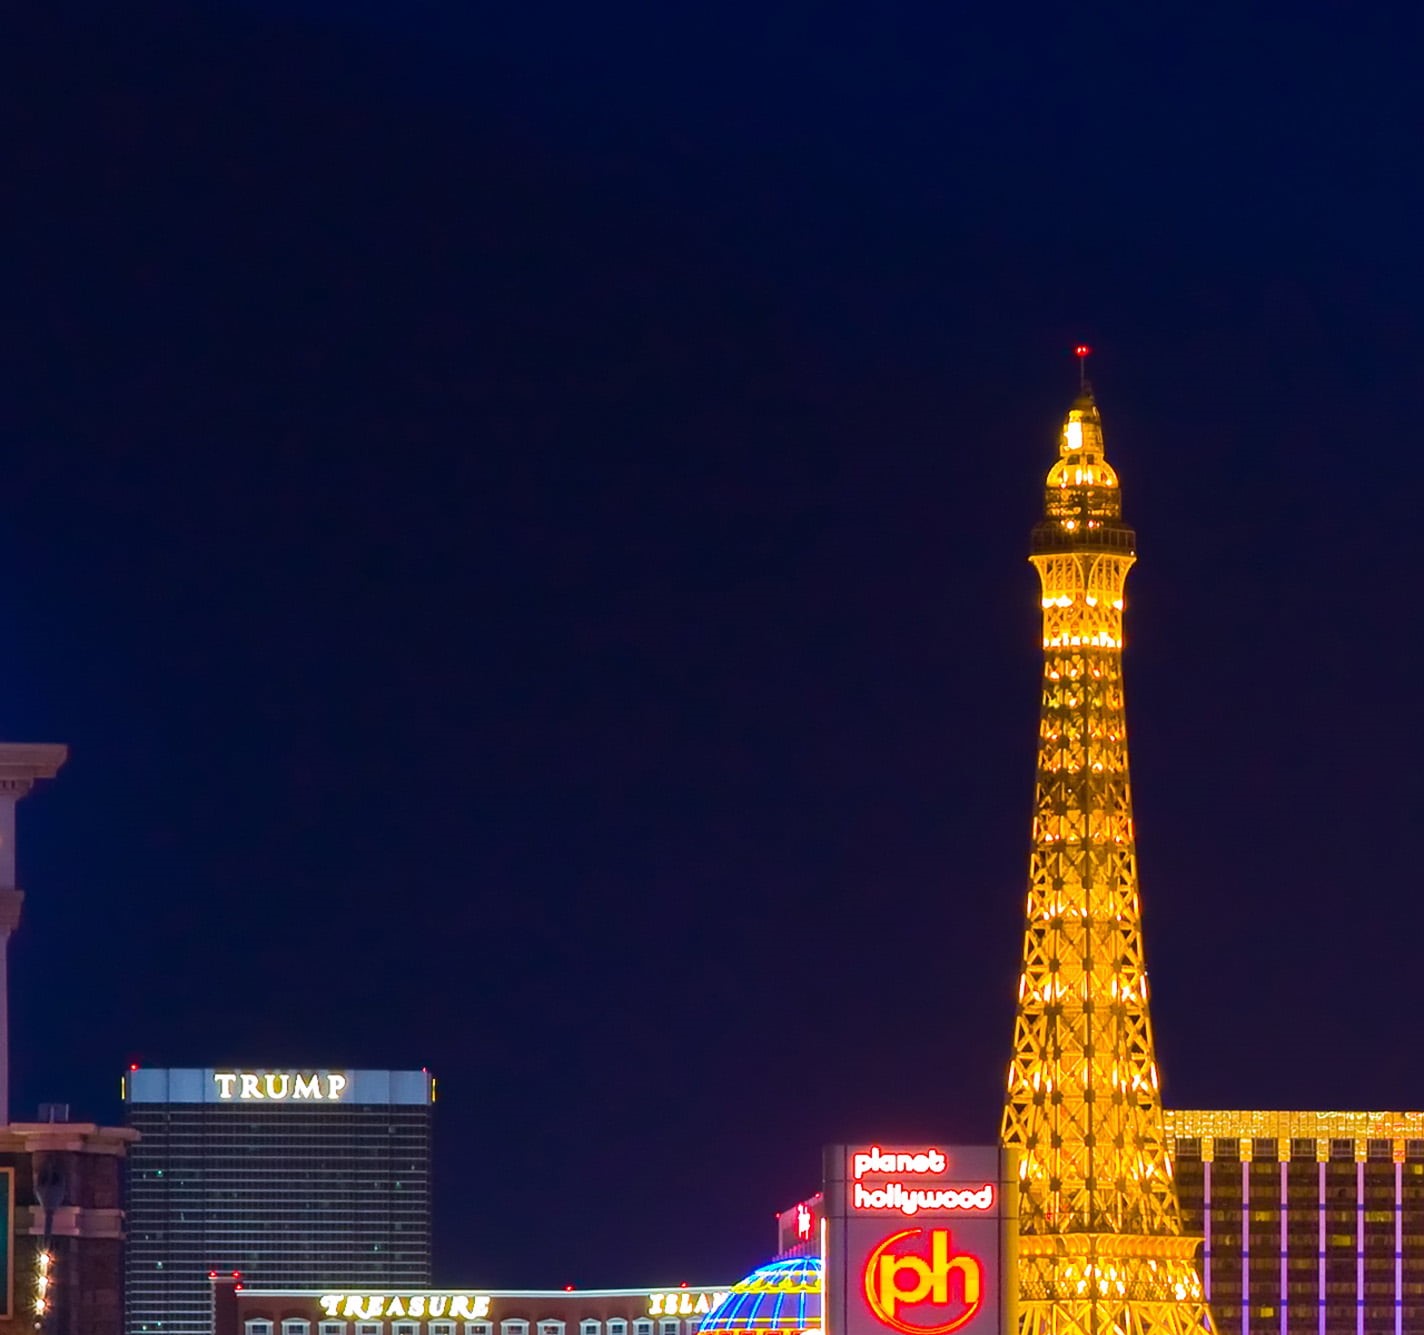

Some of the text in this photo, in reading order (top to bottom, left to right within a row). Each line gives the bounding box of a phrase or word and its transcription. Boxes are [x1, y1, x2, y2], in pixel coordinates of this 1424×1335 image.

[214, 1073, 346, 1099] TRUMP
[854, 1147, 946, 1179] planet
[854, 1183, 993, 1214] hollywood
[880, 1231, 980, 1318] ph
[320, 1294, 490, 1319] TREASURE
[649, 1293, 731, 1315] ISLA
